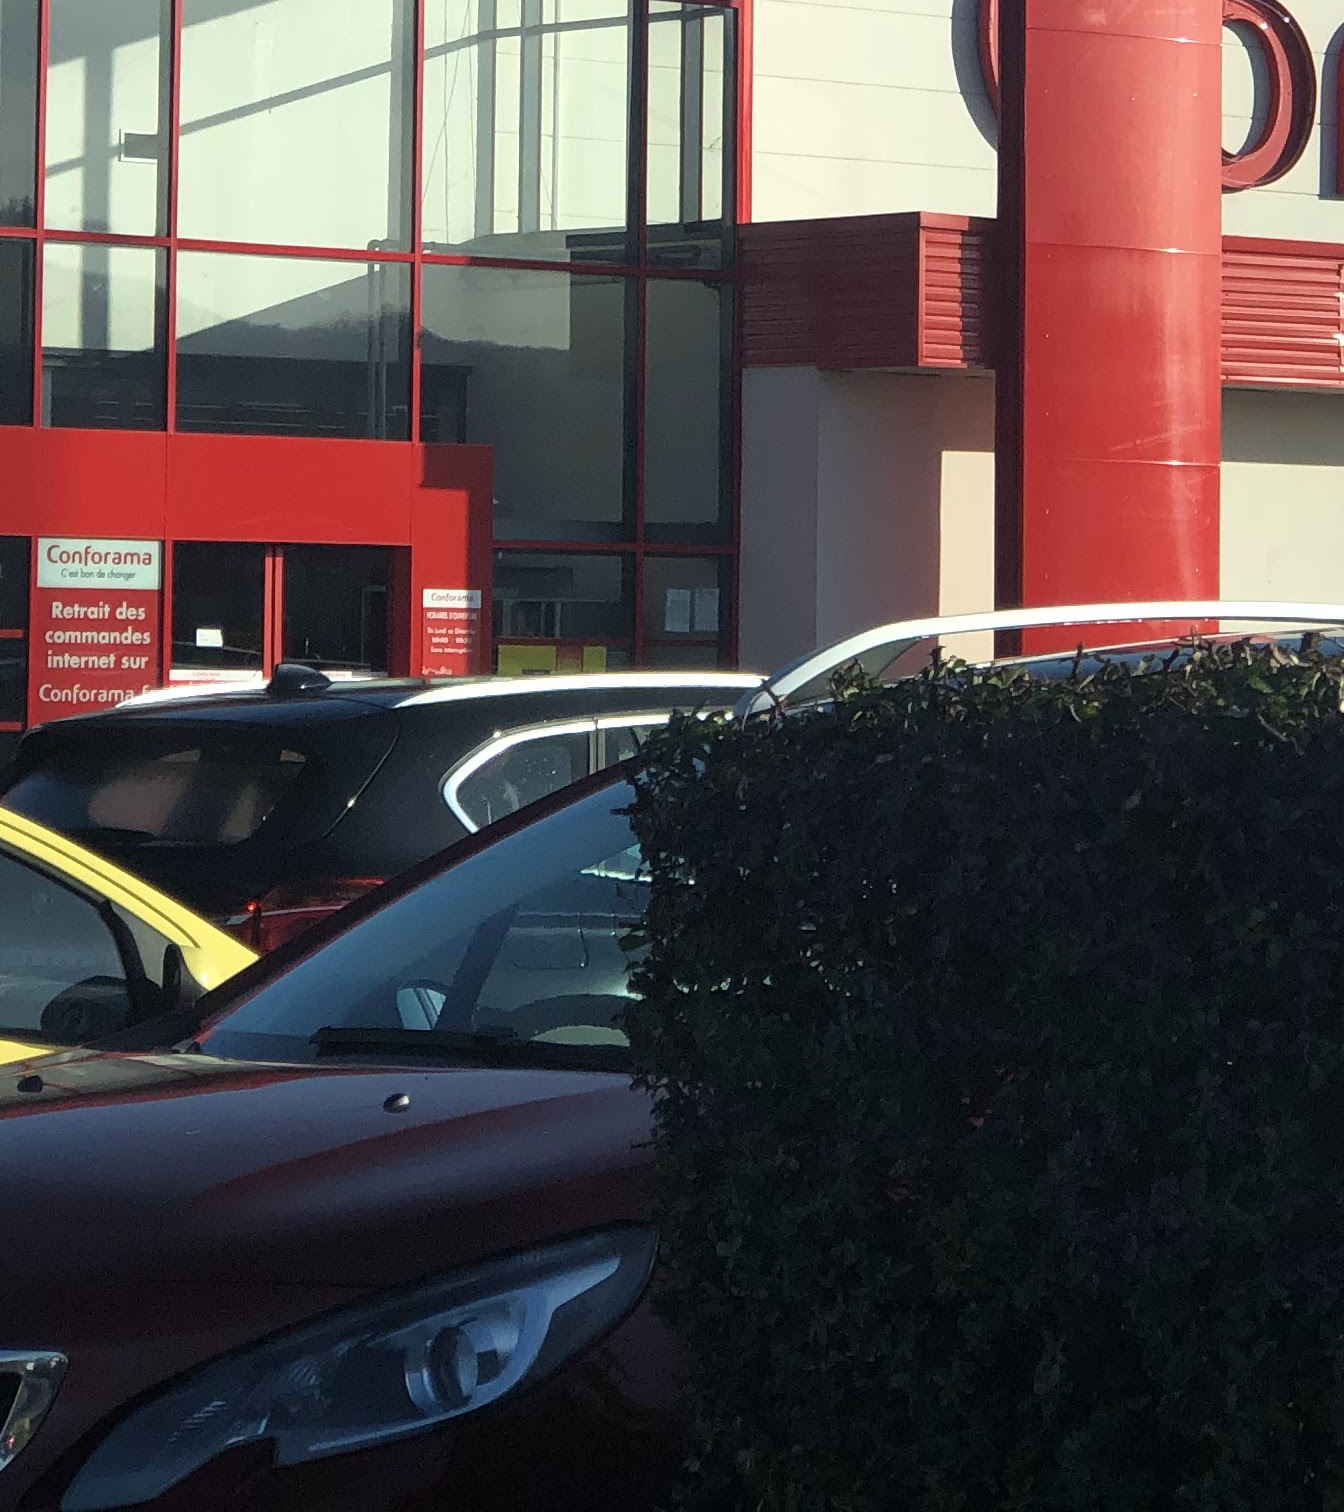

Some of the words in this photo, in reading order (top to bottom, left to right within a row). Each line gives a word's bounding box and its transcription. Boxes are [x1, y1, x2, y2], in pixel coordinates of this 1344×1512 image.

[47, 544, 152, 566] Conforama
[52, 601, 111, 619] Retrait
[115, 601, 146, 621] des
[45, 626, 151, 645] commandes
[47, 650, 116, 669] internet
[121, 654, 149, 669] sur
